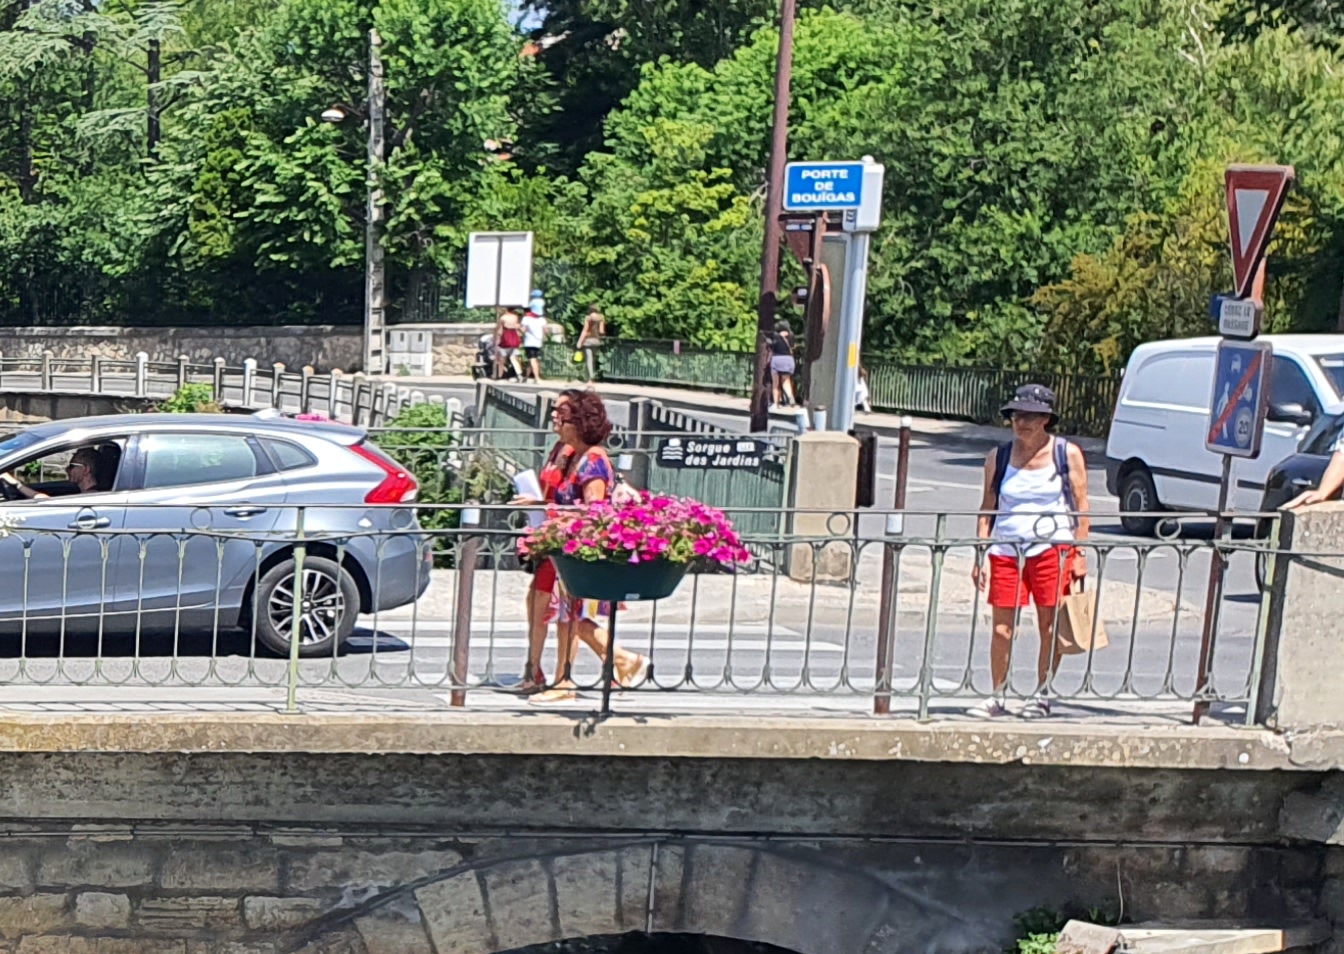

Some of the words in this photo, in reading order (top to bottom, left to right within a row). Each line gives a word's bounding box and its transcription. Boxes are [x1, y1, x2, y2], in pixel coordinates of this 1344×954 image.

[801, 169, 849, 179] PORTE
[814, 181, 834, 191] DE
[1238, 420, 1249, 434] 20
[686, 441, 730, 456] Sorgue
[685, 454, 707, 466] des
[712, 454, 759, 466] Jardins
